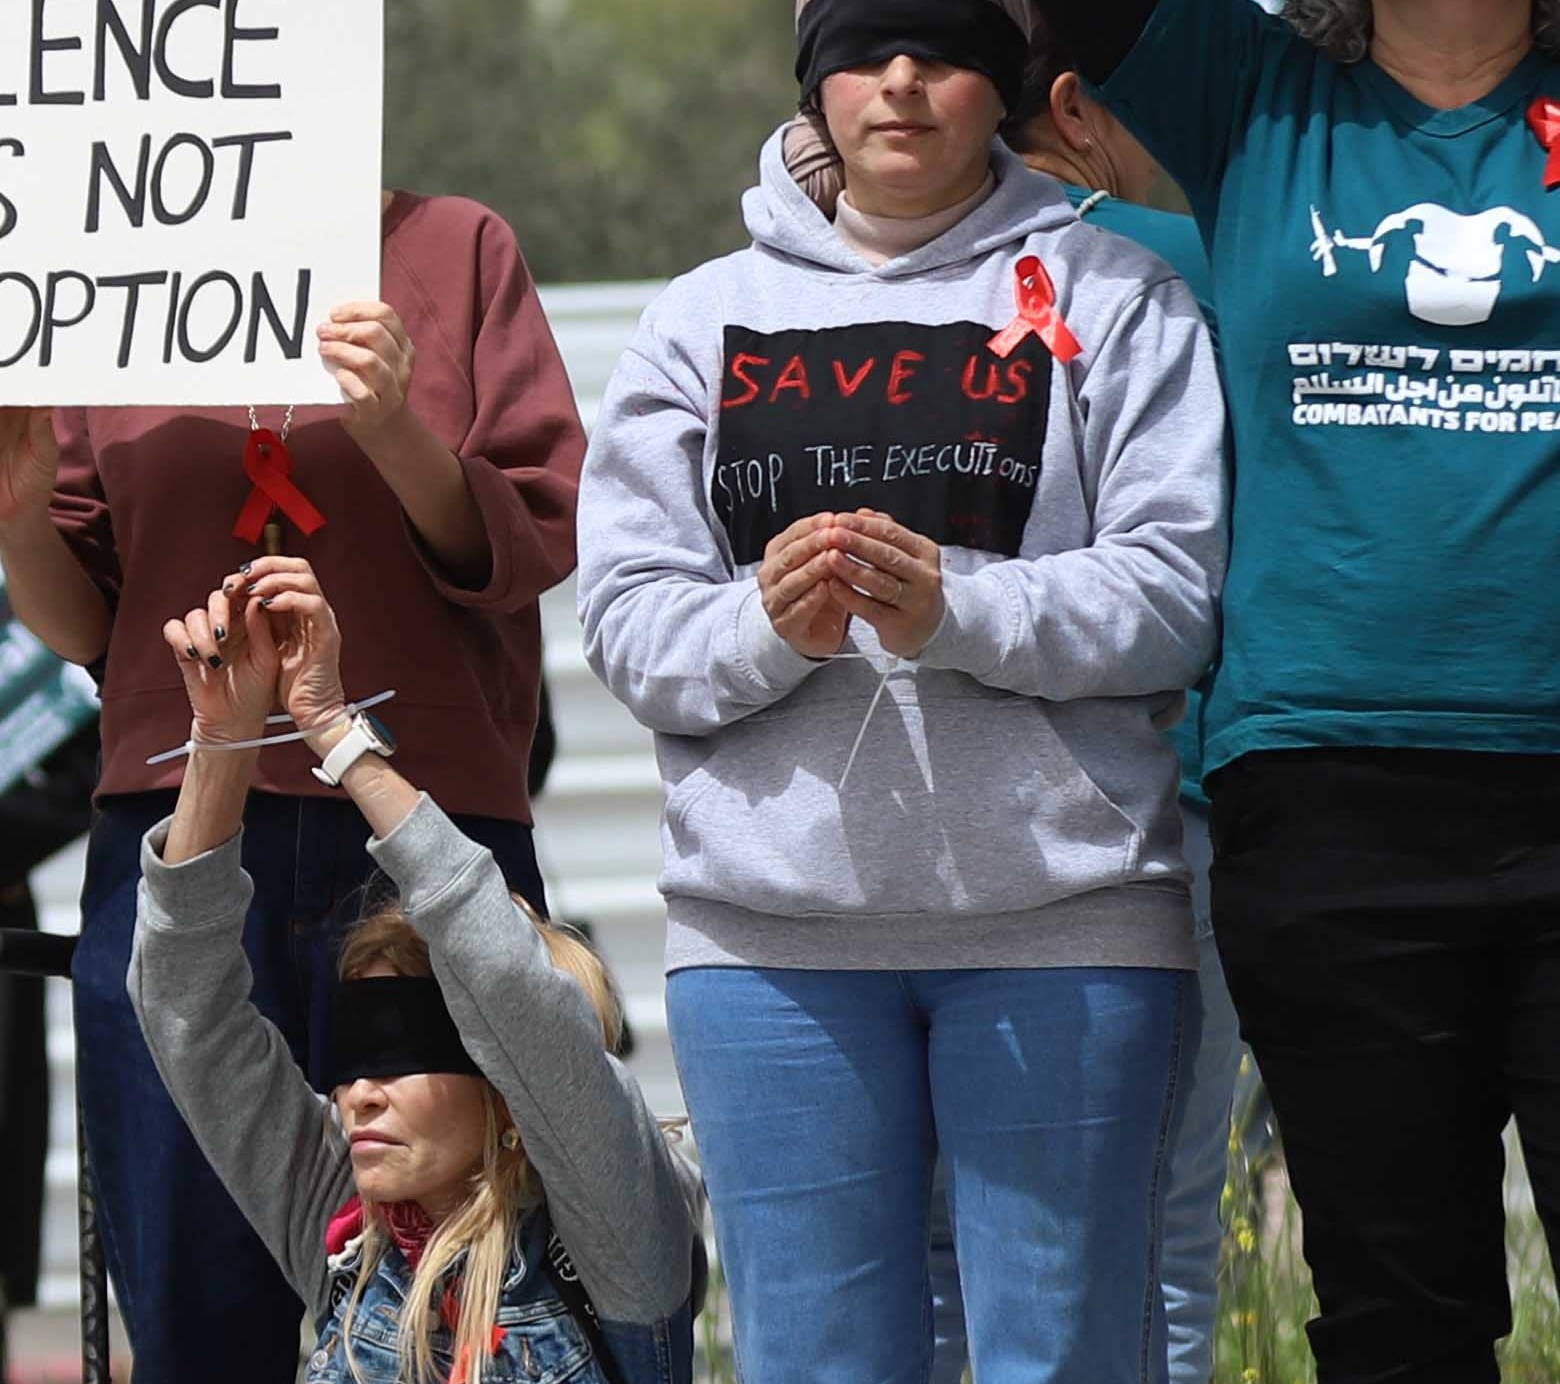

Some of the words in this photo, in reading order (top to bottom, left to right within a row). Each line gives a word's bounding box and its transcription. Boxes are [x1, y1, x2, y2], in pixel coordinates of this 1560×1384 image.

[84, 130, 292, 233] NOT
[720, 349, 928, 409] SAVE
[960, 355, 1032, 406] US
[1287, 342, 1440, 372] לשלום
[1292, 402, 1460, 431] COMBATANTS
[1464, 410, 1517, 433] FOR
[717, 452, 784, 513] STOP
[803, 443, 875, 488] THE
